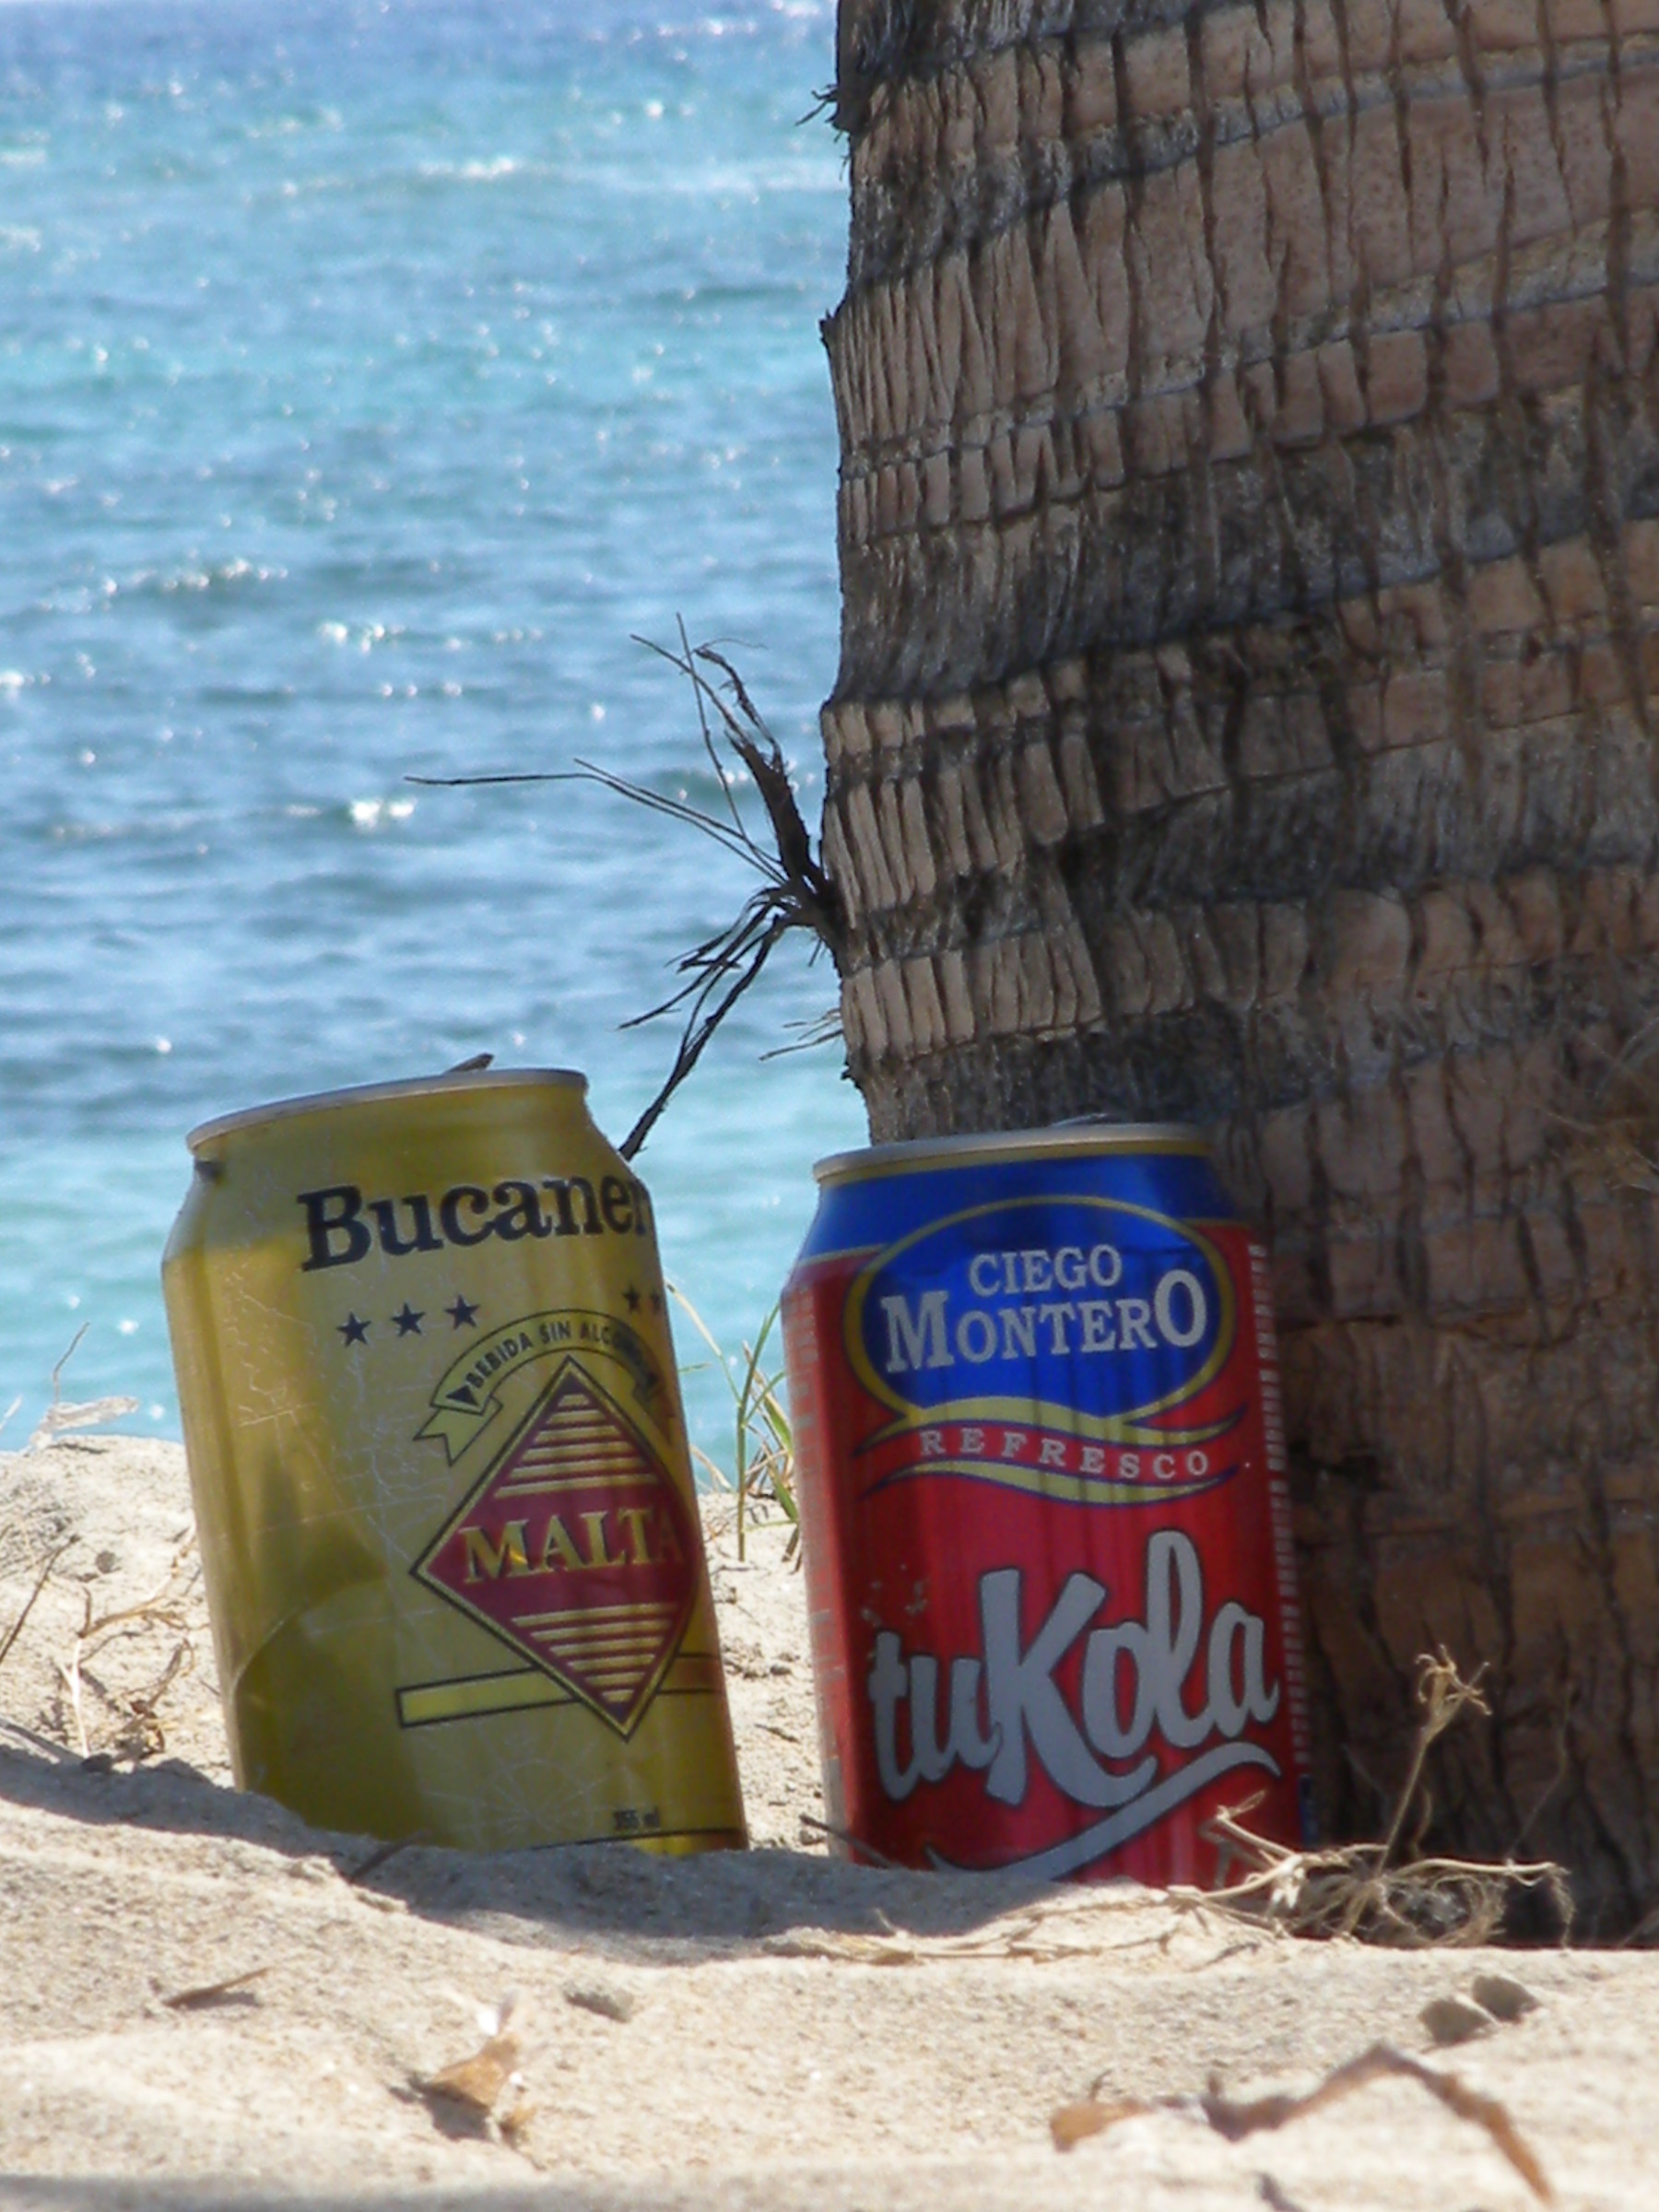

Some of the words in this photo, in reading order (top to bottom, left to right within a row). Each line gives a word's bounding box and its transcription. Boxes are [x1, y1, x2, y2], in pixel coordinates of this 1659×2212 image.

[969, 1244, 1123, 1297] CIEGO
[880, 1268, 1206, 1373] MONTERO
[465, 1333, 533, 1389] BEBIDA
[538, 1321, 571, 1345] SIN
[920, 1427, 1209, 1479] REFRESCO
[459, 1505, 686, 1583] MALTA
